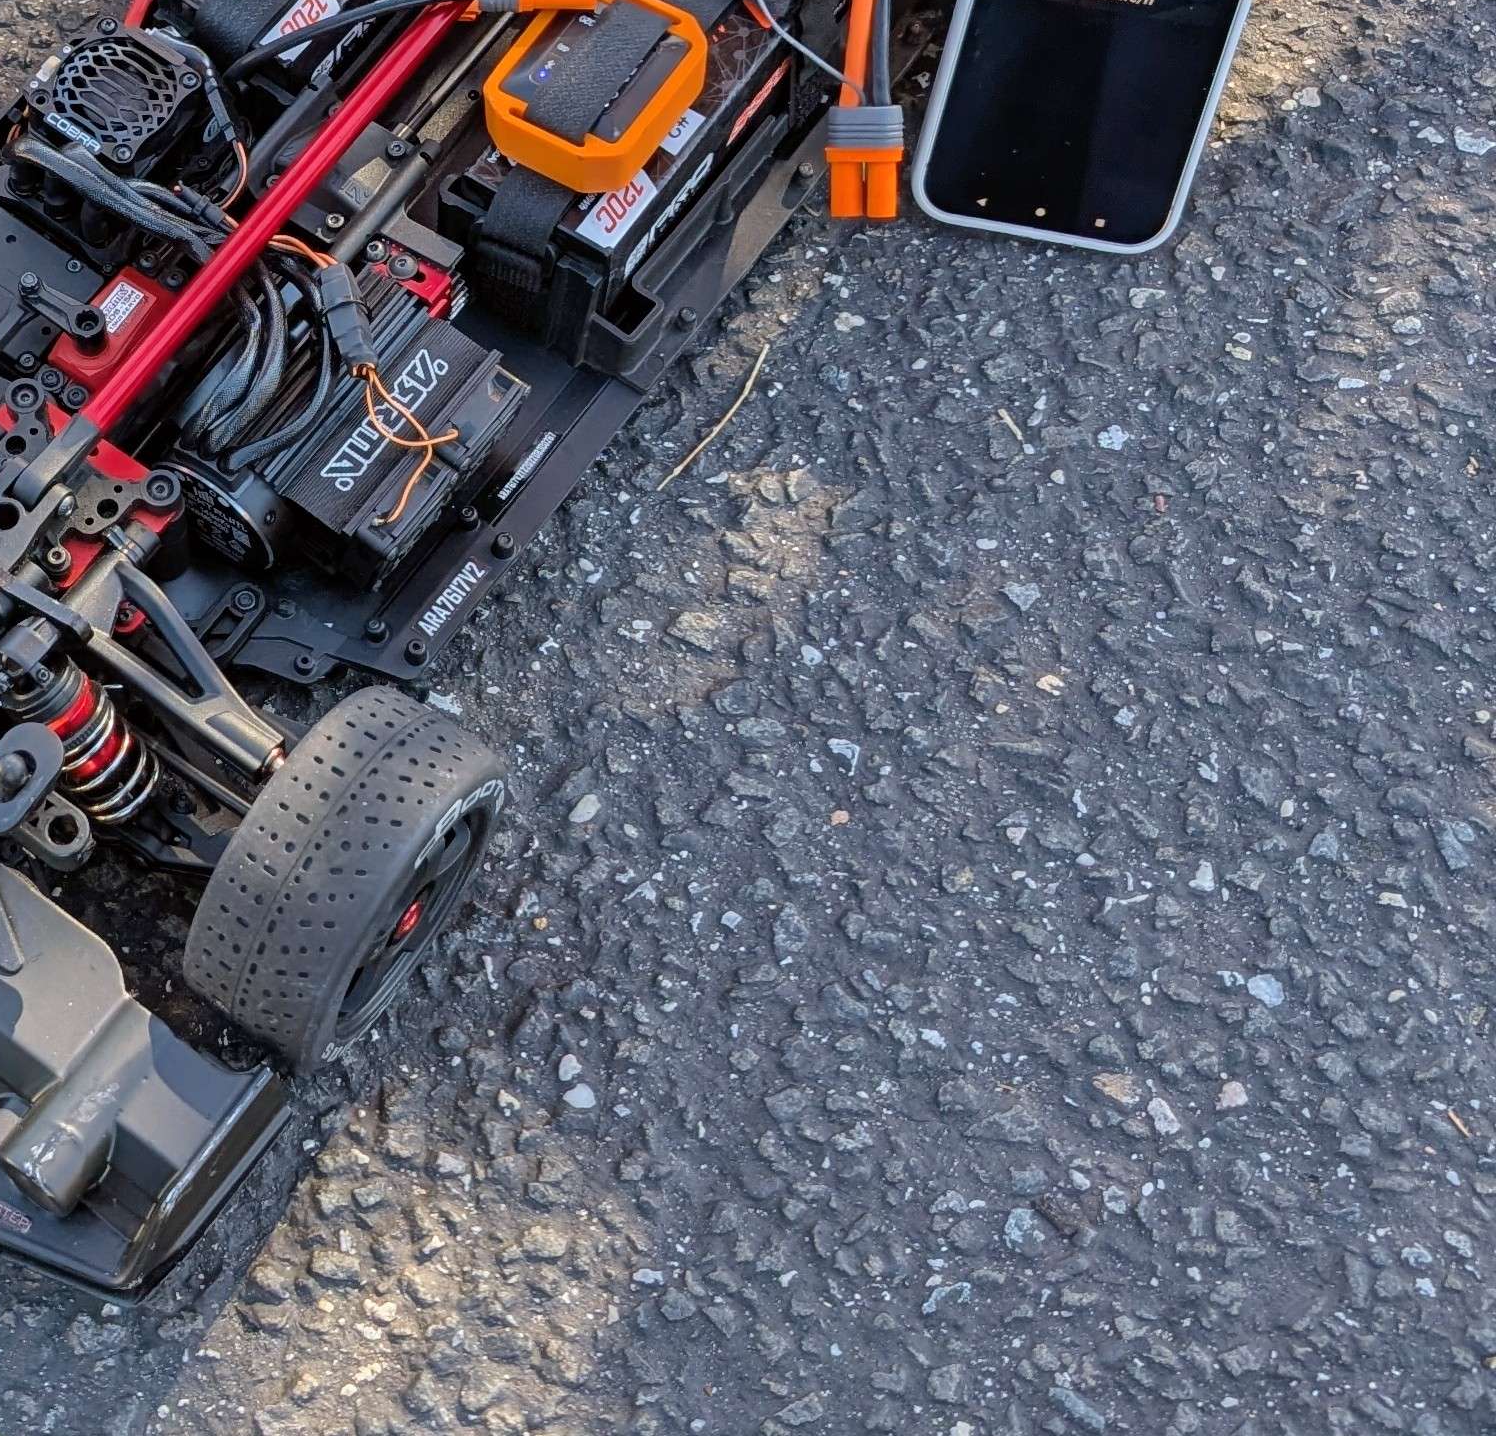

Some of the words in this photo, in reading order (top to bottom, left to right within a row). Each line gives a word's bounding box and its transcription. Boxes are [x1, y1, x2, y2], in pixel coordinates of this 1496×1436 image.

[45, 109, 102, 155] COBRA
[590, 173, 647, 235] 120C
[415, 558, 487, 638] ARA7617V2
